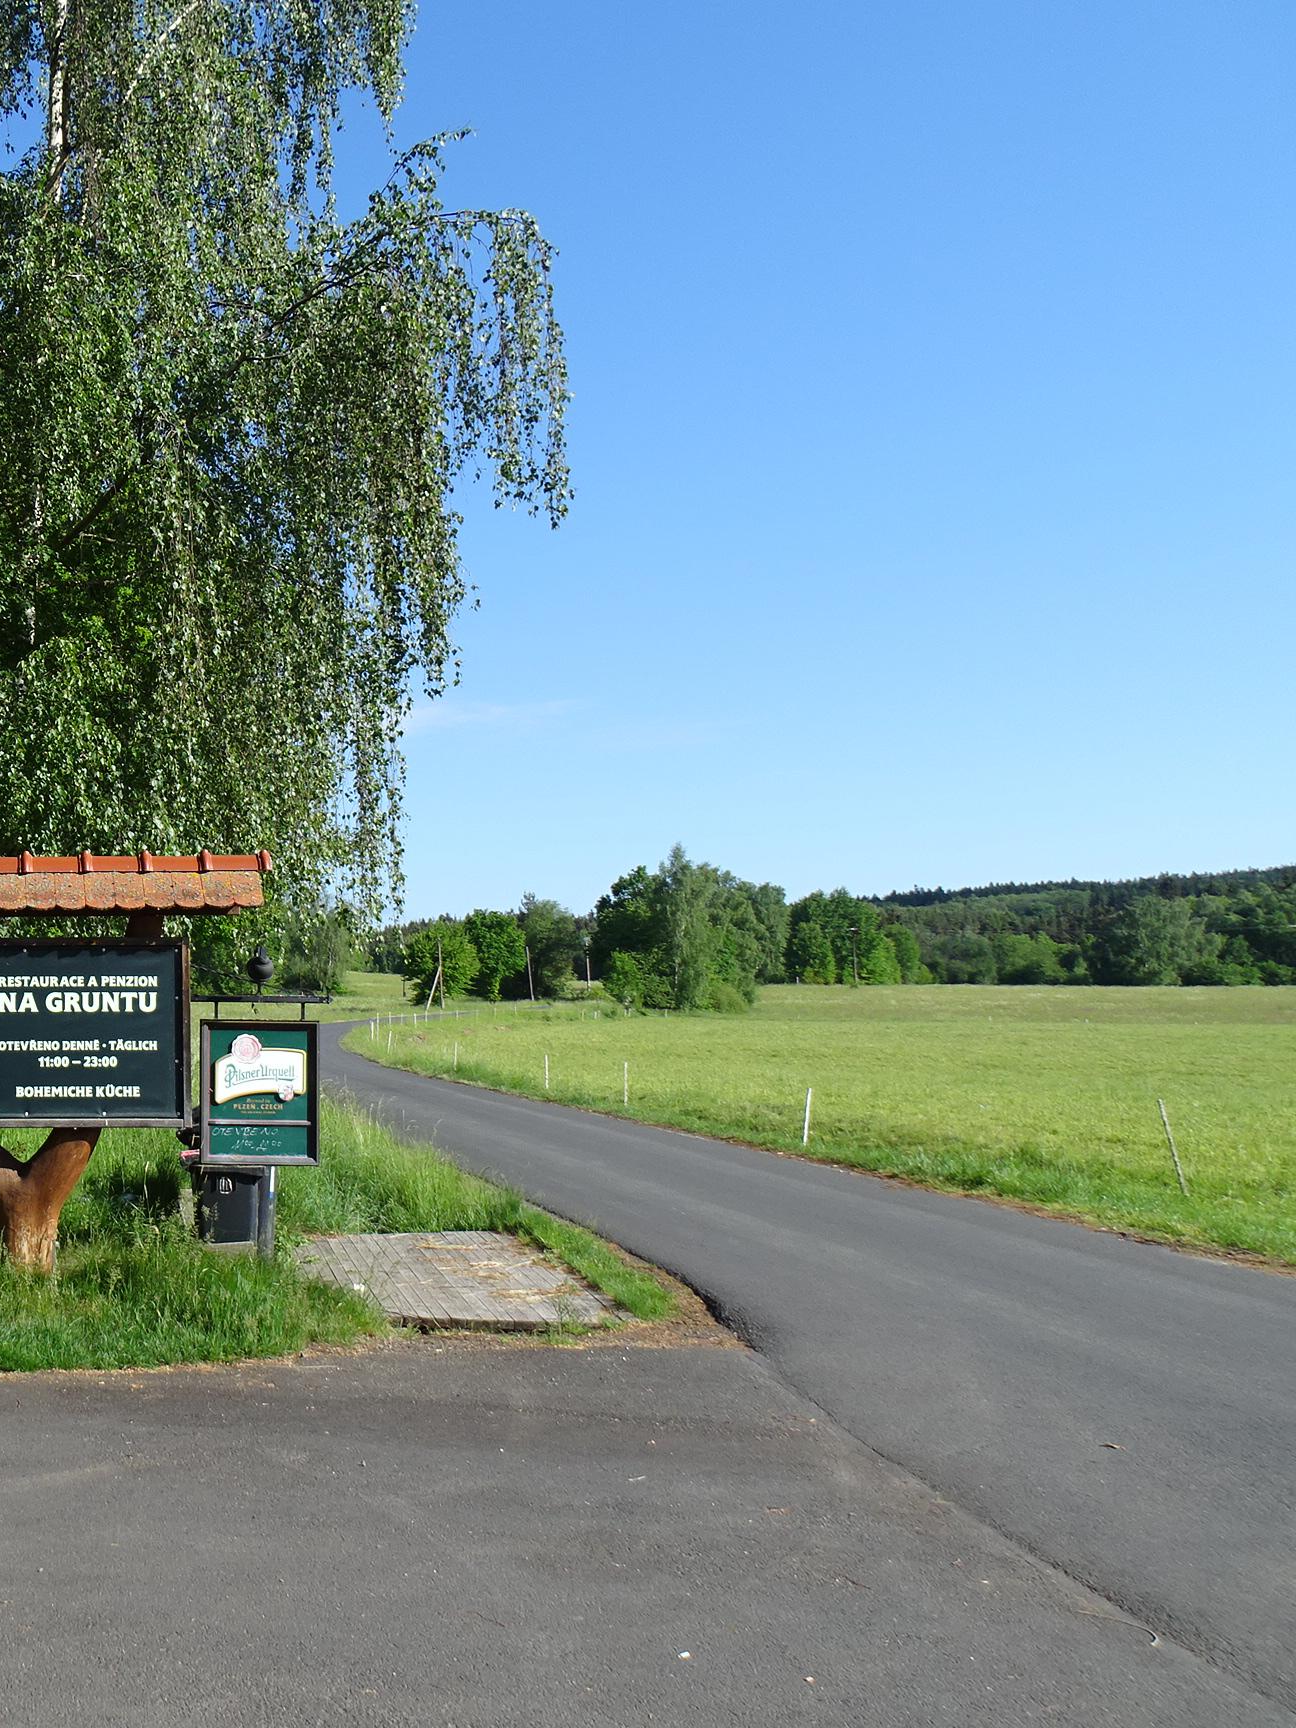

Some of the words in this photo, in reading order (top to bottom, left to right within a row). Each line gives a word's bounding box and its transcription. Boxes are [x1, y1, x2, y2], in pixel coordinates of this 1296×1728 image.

[87, 975, 99, 988] A
[100, 975, 158, 988] PENZION
[45, 991, 158, 1013] GRUNTU
[62, 1039, 100, 1051] DENNĚ
[108, 1038, 158, 1051] TÄGLICH
[37, 1056, 70, 1068] 11:00
[82, 1056, 118, 1068] 23:00
[224, 1063, 260, 1089] Pilsner
[259, 1063, 295, 1082] Urquell
[15, 1085, 93, 1098] BOHEMICHE
[95, 1083, 141, 1098] KÜCHE
